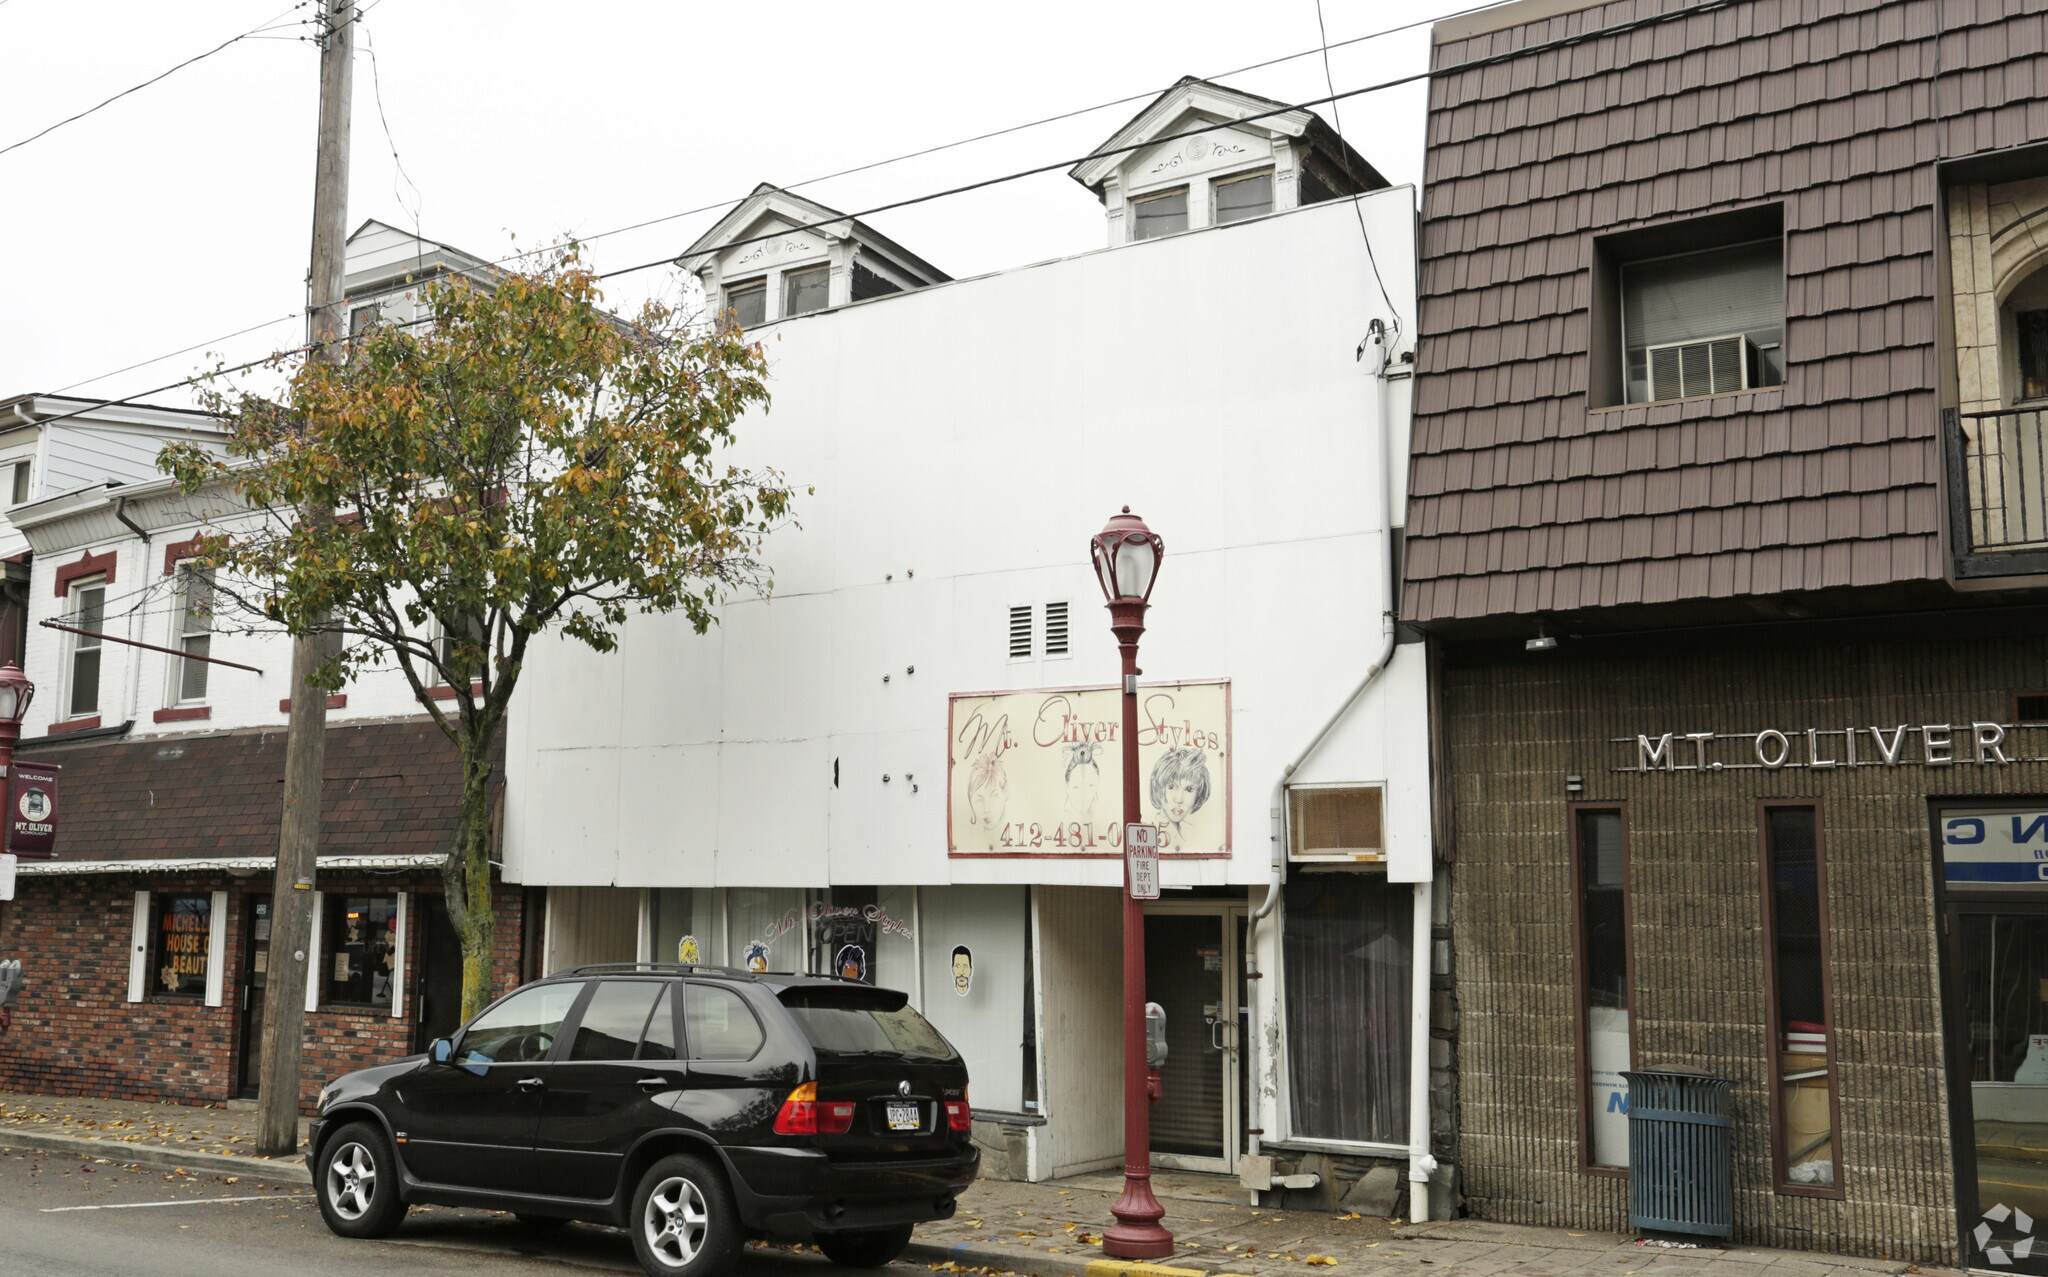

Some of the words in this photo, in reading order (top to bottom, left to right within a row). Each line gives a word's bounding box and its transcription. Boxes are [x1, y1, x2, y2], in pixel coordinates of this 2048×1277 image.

[958, 702, 1018, 760] Mt.
[1033, 695, 1120, 747] Oliver
[1137, 693, 1219, 753] Styles
[1637, 731, 1723, 773] MT.
[1754, 721, 2009, 770] OLIVER
[18, 773, 53, 782] WELCOME
[15, 821, 28, 831] MT.
[28, 822, 53, 833] OLIVER
[1136, 828, 1148, 843] NO
[1129, 844, 1157, 859] PARKING
[1136, 860, 1150, 871] FIRE
[1136, 872, 1151, 882] DEPT
[1137, 883, 1152, 894] ONLY
[163, 913, 209, 933] MICHELL
[817, 922, 875, 945] OPEN
[166, 934, 200, 953] HOUSE
[172, 955, 208, 975] BEAUT
